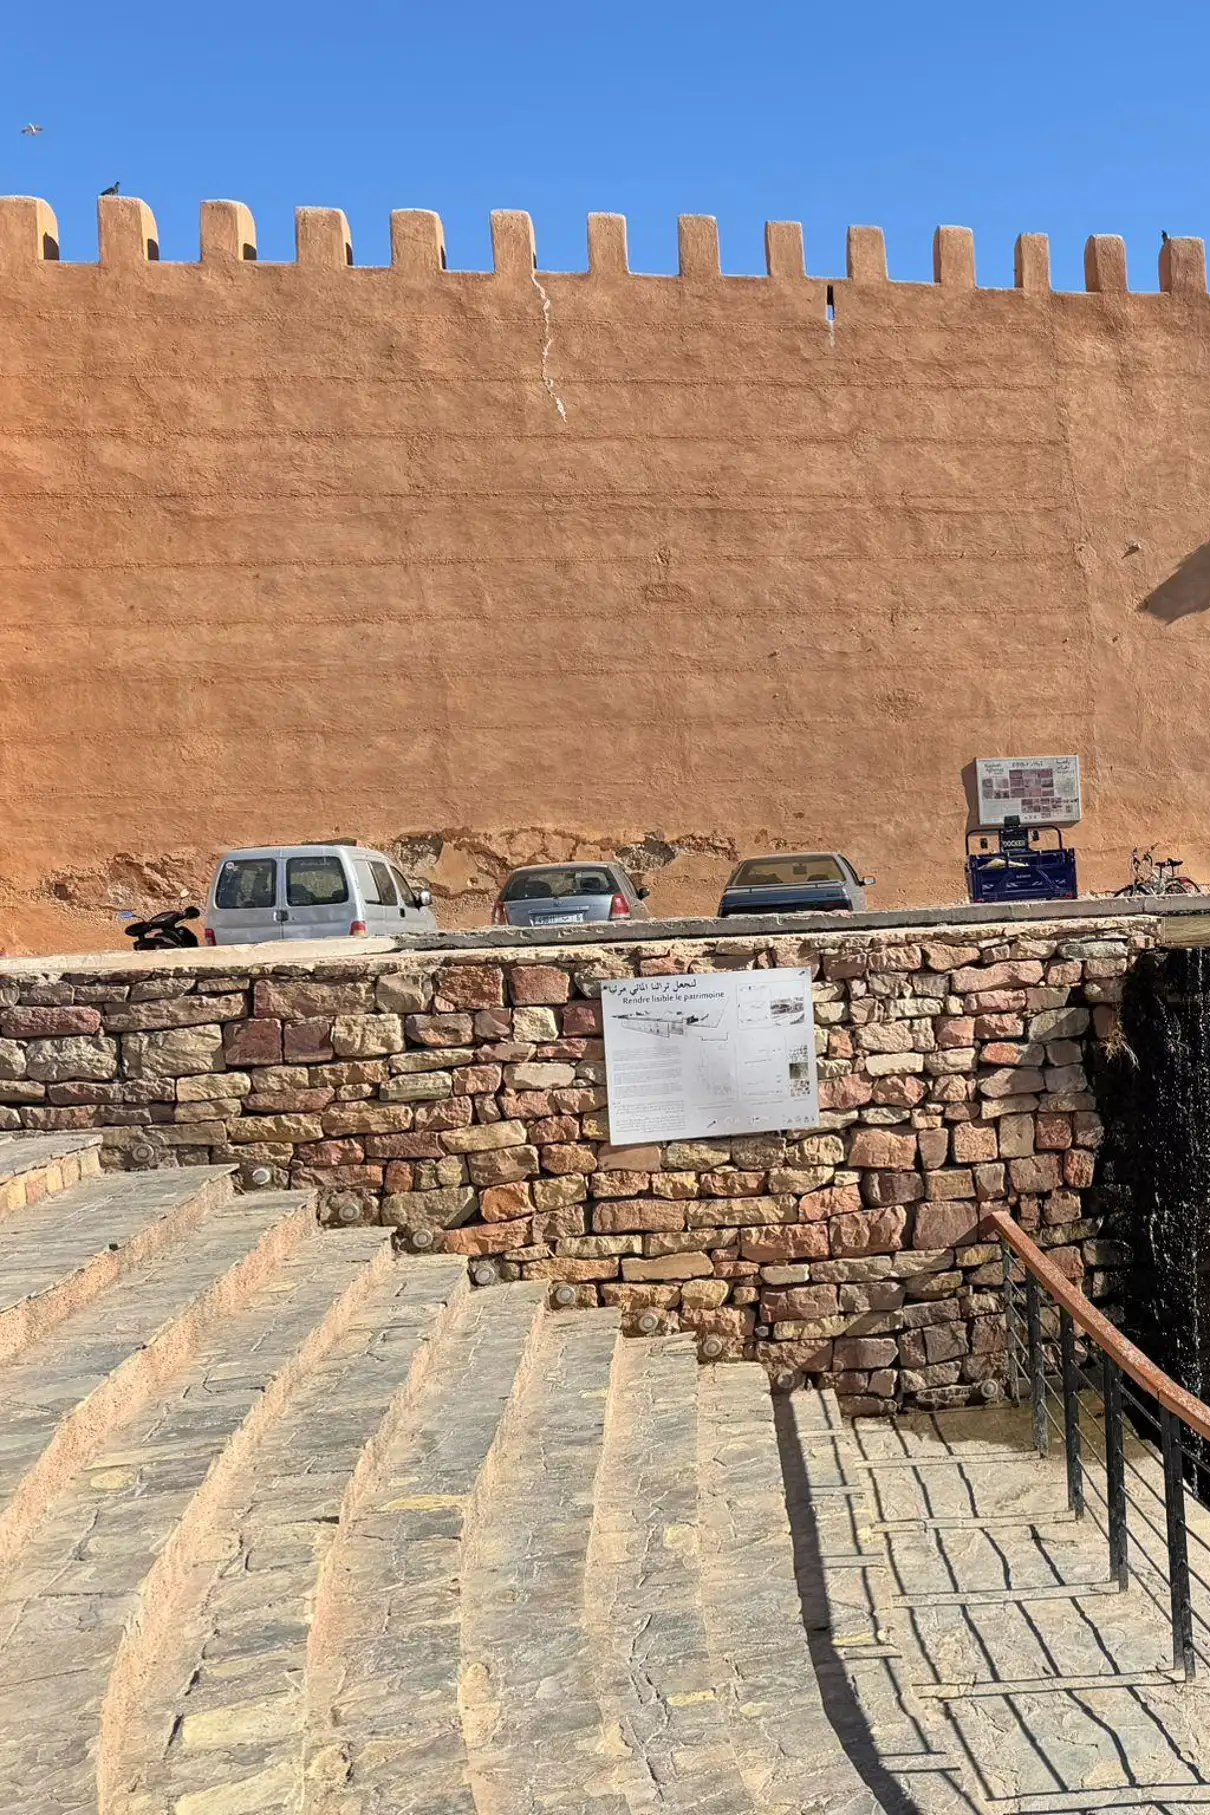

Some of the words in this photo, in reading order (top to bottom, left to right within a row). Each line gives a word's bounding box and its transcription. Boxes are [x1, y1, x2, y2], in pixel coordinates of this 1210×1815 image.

[623, 996, 650, 1004] Rendre
[651, 994, 674, 1003] lisible
[675, 993, 682, 1001] le
[684, 992, 725, 1001] patrimoine
